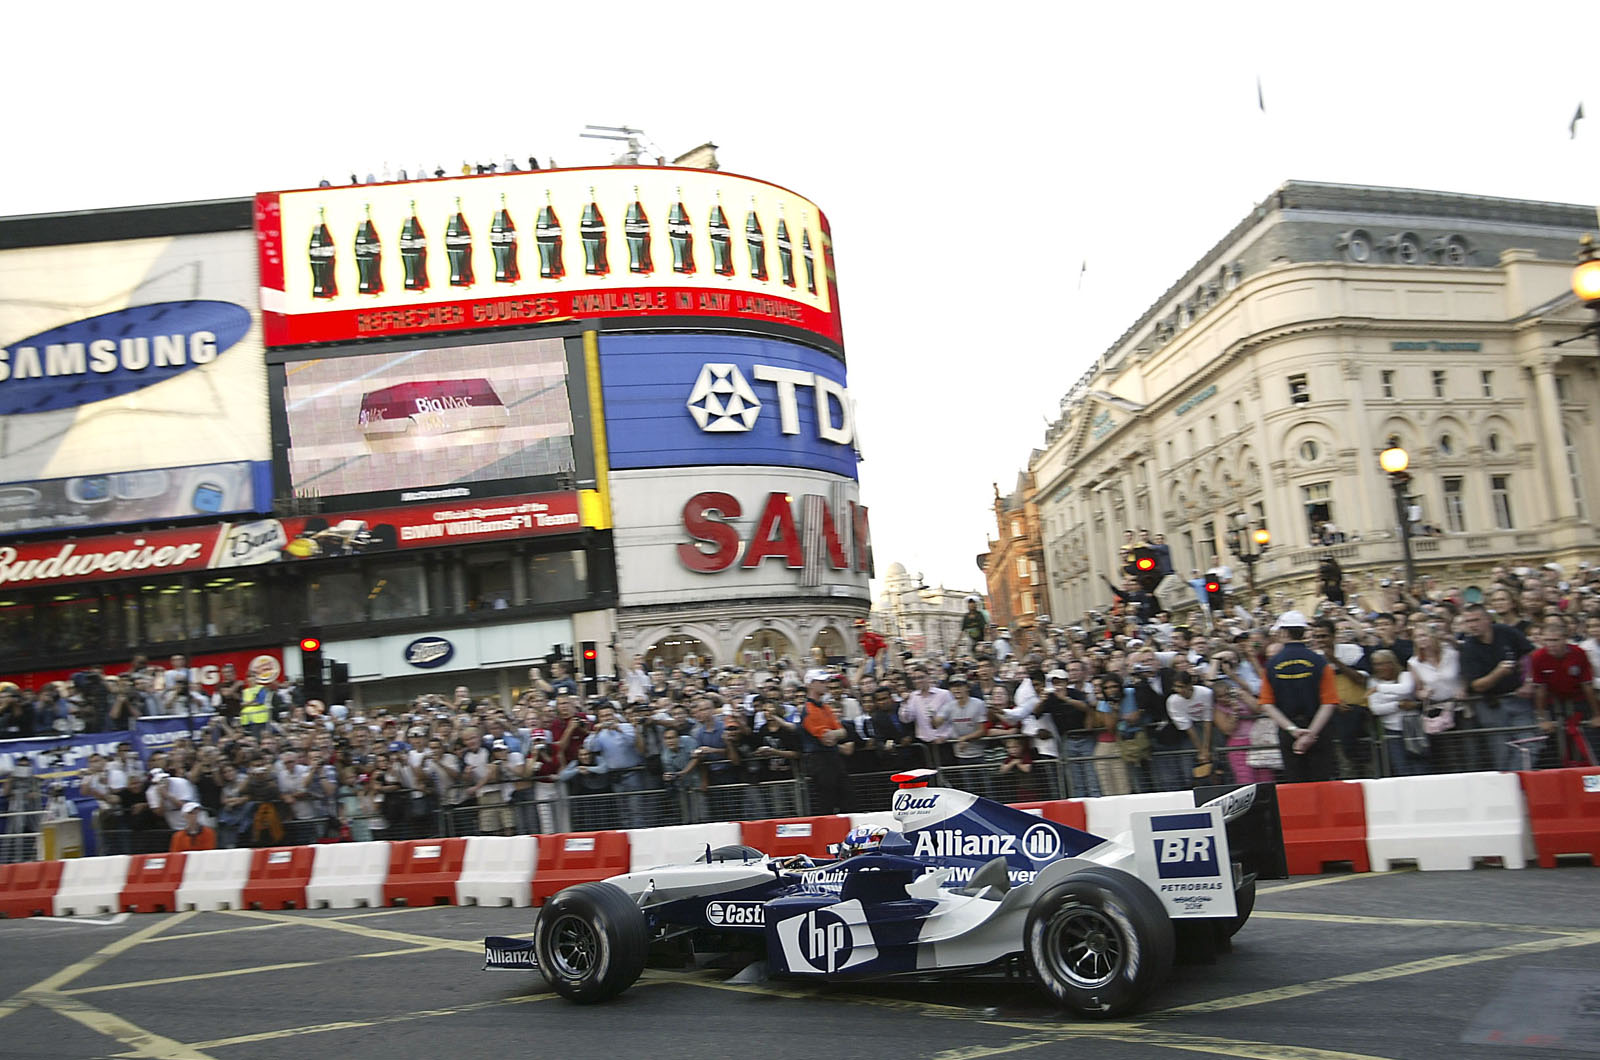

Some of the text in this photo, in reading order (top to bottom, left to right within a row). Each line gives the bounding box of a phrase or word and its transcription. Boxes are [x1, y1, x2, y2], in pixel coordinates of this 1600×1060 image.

[357, 305, 464, 332] REFRESHER
[473, 297, 560, 322] COURSES
[572, 292, 668, 313] AVAILABLE
[753, 365, 857, 445] TD
[401, 523, 444, 540] BMW
[533, 513, 579, 527] Team
[895, 793, 940, 811] Bud
[914, 830, 1017, 857] Allianz
[1160, 836, 1211, 864] BR
[801, 868, 849, 885] NiQuiti
[1160, 882, 1223, 892] PETROBRAS
[485, 947, 529, 963] Allianz
[808, 910, 844, 973] hp
